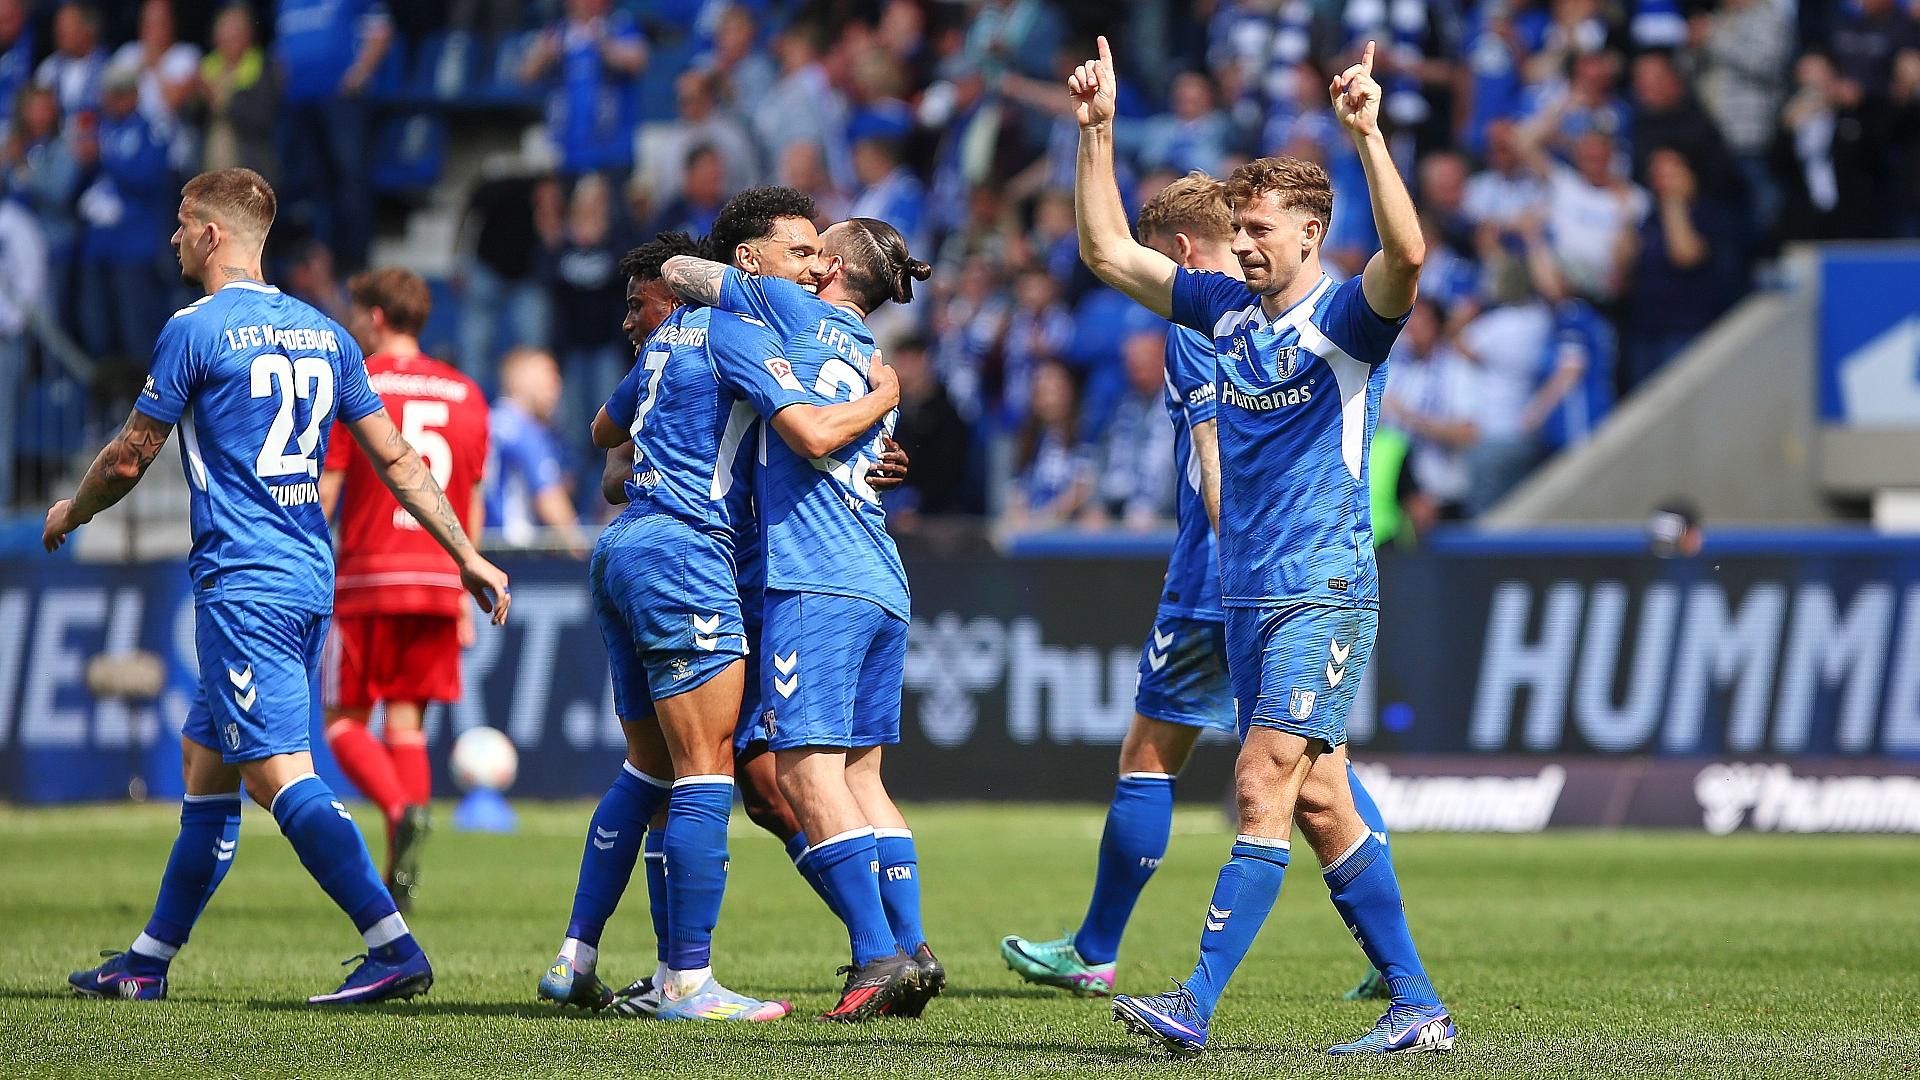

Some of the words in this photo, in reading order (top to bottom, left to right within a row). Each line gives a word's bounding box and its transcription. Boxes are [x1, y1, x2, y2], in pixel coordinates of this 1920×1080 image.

[225, 325, 262, 351] 1.FC
[815, 318, 849, 354] 1.FC
[249, 352, 334, 479] 22
[401, 399, 454, 492] 5
[886, 866, 912, 882] FCM
